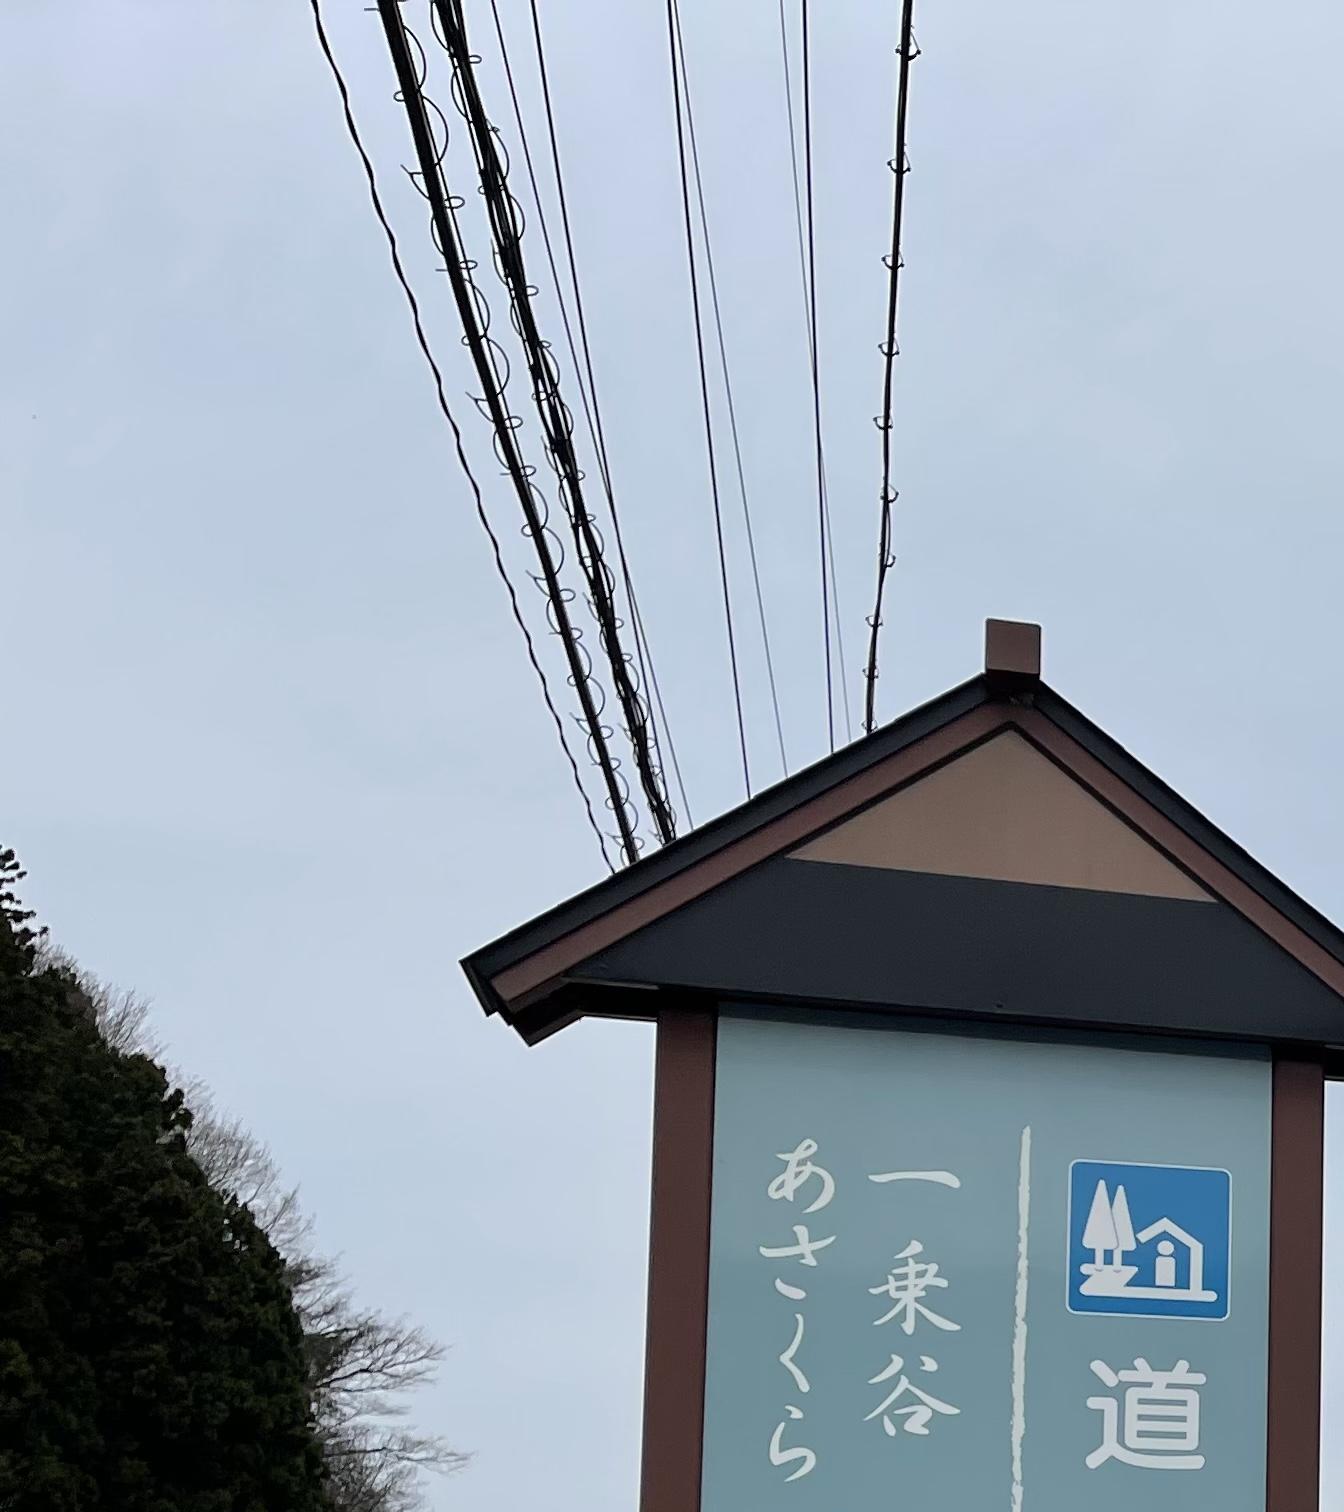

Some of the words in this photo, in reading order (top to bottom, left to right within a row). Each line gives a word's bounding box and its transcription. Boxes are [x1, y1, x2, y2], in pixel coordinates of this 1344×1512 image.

[759, 1137, 838, 1483] あさくら
[862, 1168, 962, 1438] 一乗谷
